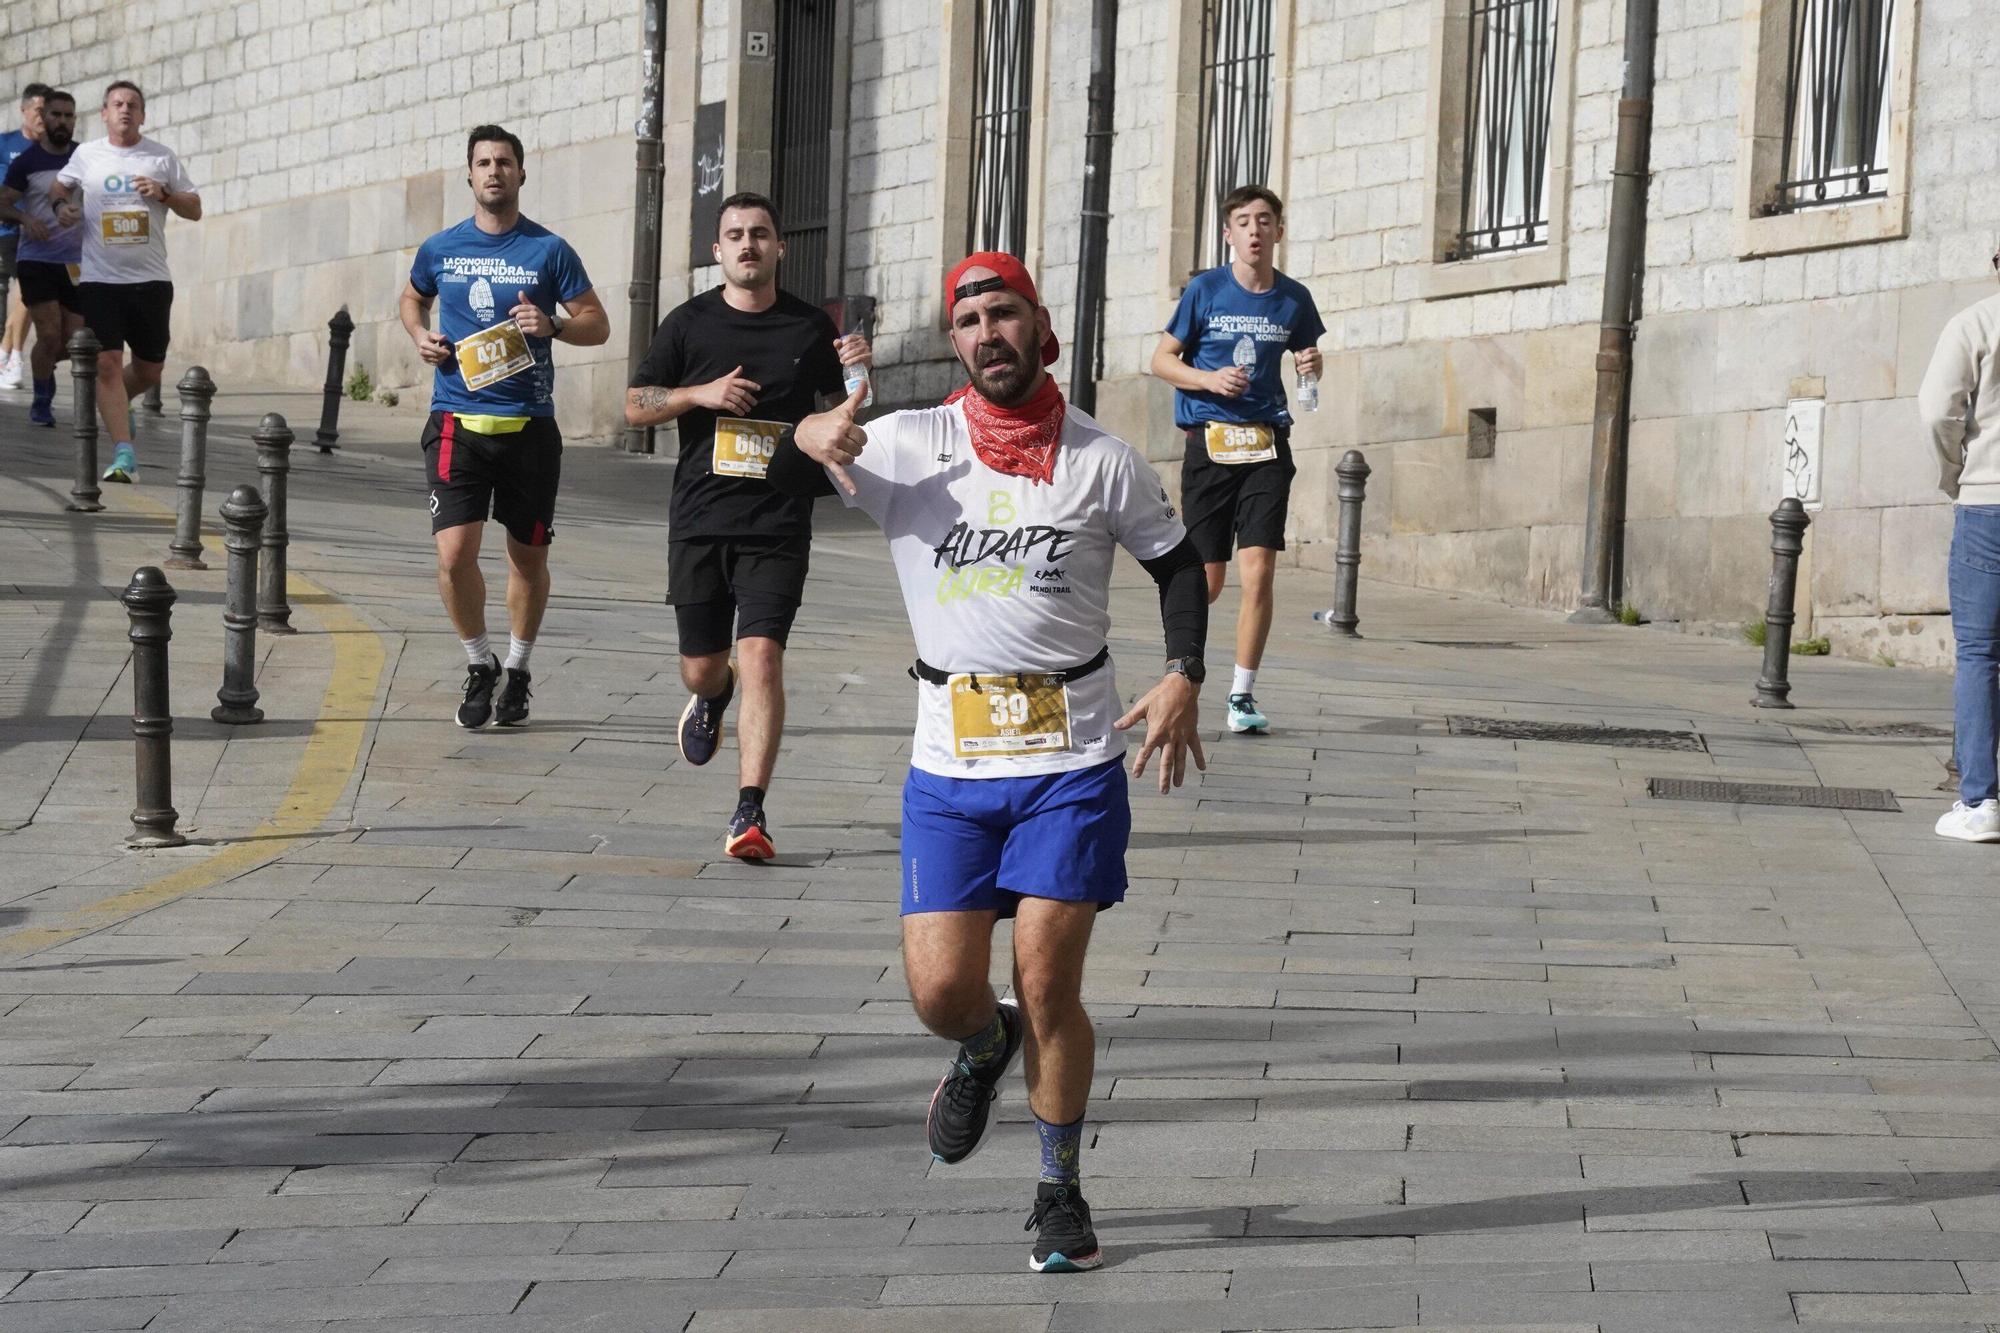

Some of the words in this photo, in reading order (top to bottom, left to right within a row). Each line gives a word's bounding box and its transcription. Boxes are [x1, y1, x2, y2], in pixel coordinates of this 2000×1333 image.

[112, 218, 139, 233] 500
[443, 257, 453, 265] LA
[454, 257, 506, 266] CONQUISTA
[455, 265, 525, 276] ALMENDRA
[491, 275, 539, 285] KONKISTA
[1220, 315, 1269, 324] CONQUISTA
[1221, 322, 1284, 334] ALMENDRA
[1224, 428, 1258, 447] 355
[736, 432, 775, 458] 606
[987, 489, 1017, 525] B
[933, 521, 1074, 569] ALDAPE
[1030, 585, 1051, 593] MENDI
[989, 693, 1029, 726] 39
[1000, 728, 1021, 736] ASIER
[912, 857, 920, 903] SALOMON
